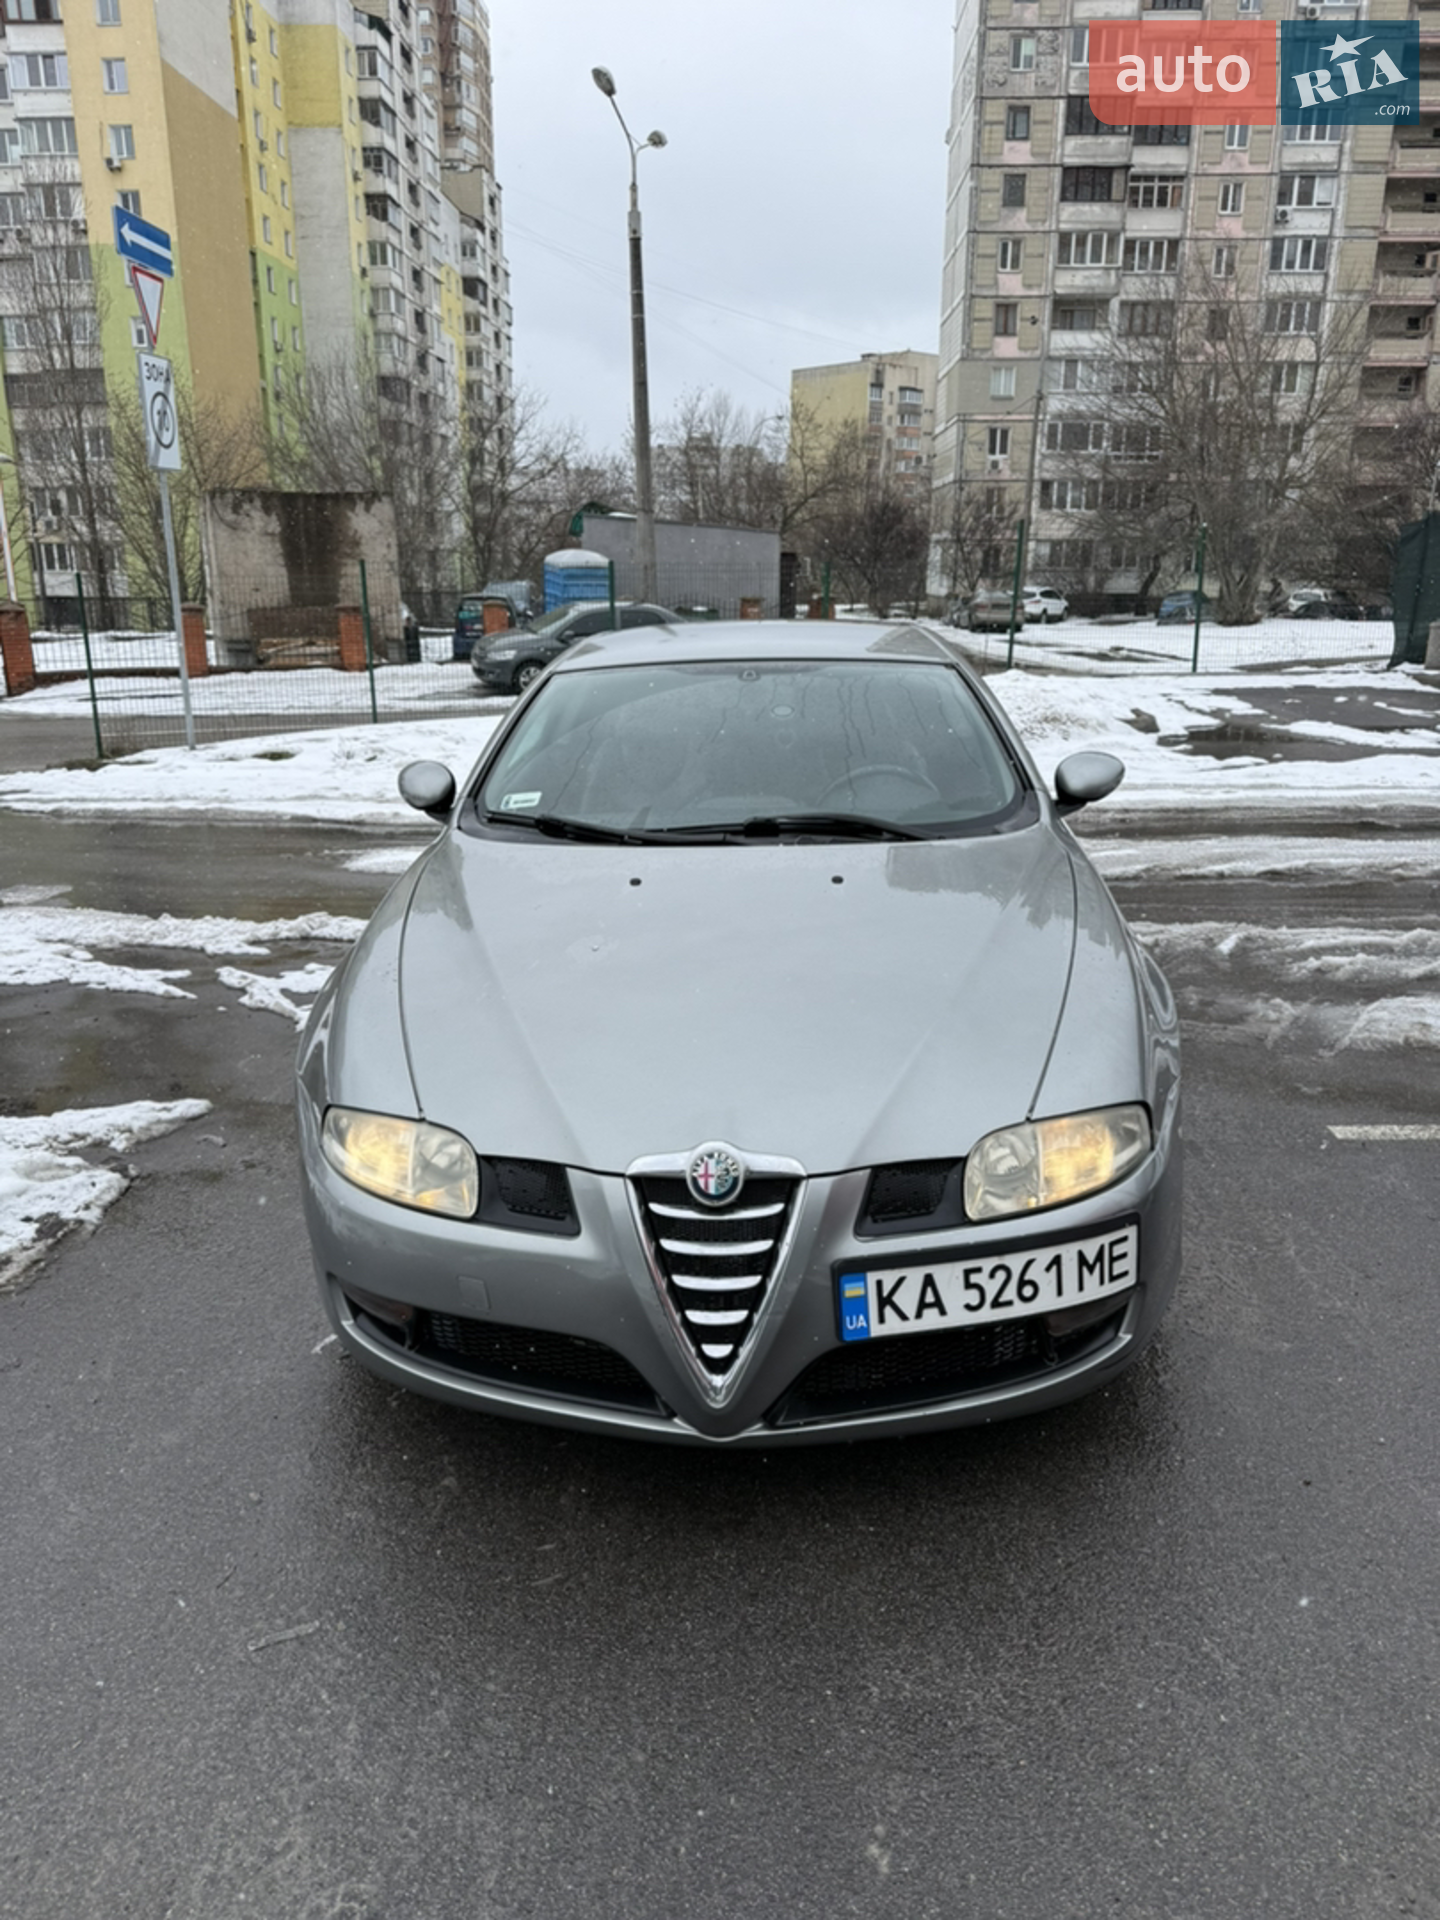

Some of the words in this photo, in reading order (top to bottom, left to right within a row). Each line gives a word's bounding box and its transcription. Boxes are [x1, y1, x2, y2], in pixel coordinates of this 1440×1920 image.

[875, 1272, 948, 1325] KA
[963, 1253, 1064, 1312] 5261
[1077, 1234, 1130, 1293] ME
[845, 1314, 868, 1330] UA
